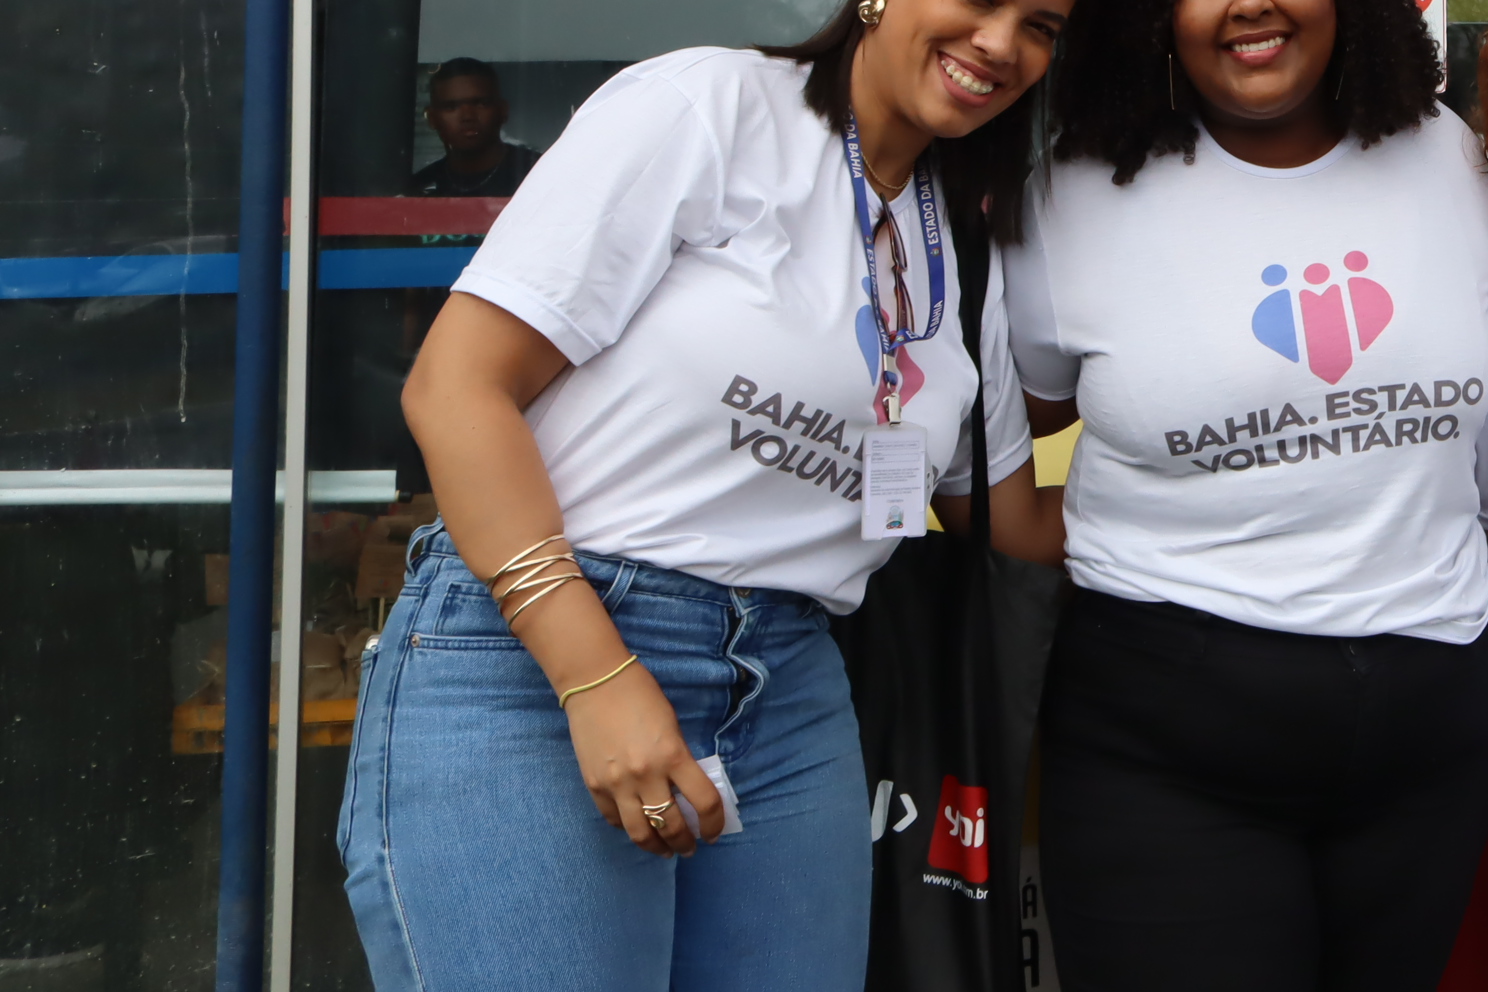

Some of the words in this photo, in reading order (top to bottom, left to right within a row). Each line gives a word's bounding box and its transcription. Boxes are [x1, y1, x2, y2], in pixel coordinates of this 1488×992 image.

[847, 142, 862, 178] BAHIA
[920, 183, 932, 201] DA
[923, 202, 939, 245] ESTADO
[721, 374, 850, 455] BAHIA.
[1165, 402, 1319, 457] BAHIA.
[1325, 377, 1484, 421] ESTADO
[731, 418, 862, 502] VOLUNT
[1191, 411, 1460, 473] VOLUNTÁRIO.
[944, 805, 985, 848] yoi
